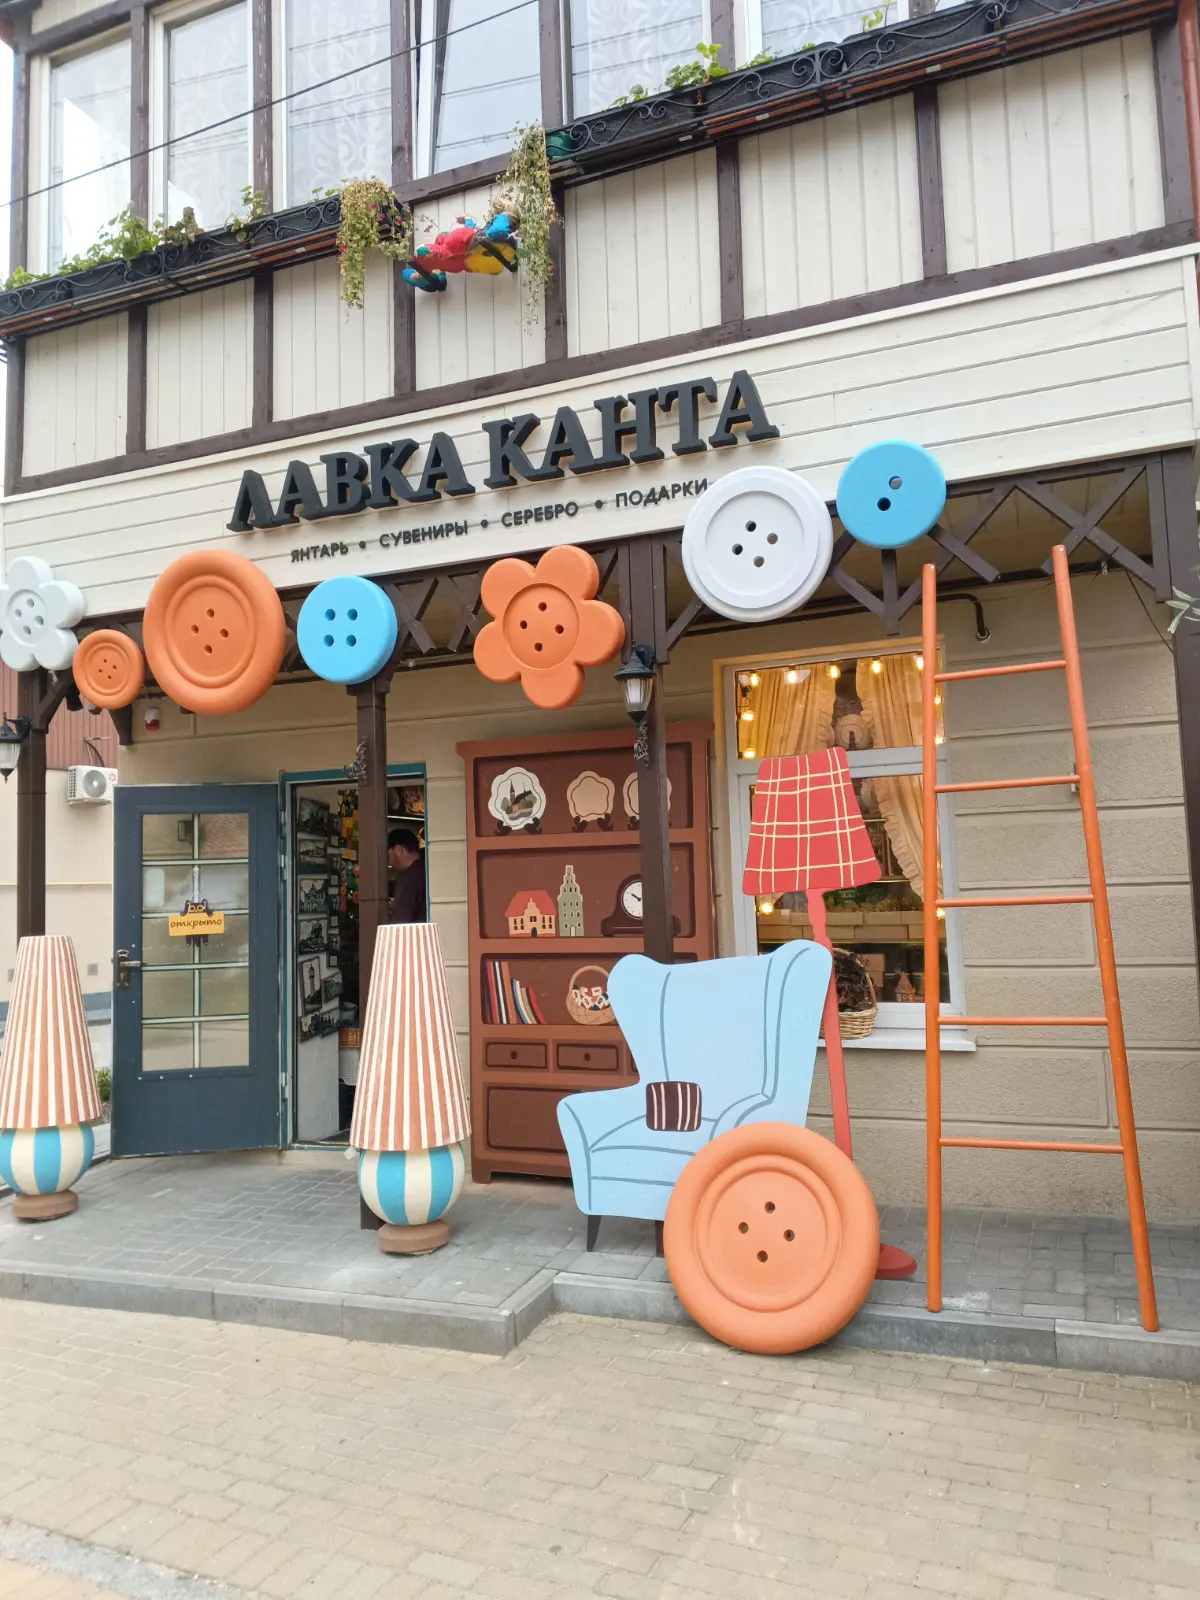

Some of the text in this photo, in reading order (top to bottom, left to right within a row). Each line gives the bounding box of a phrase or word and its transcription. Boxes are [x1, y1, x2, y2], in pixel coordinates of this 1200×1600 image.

[226, 369, 780, 533] ЛАВКА КАНТА
[291, 478, 708, 563] ЯНТАРЬ СУВЕНИРЫ СЕРЕБРО ПОДАРКИ
[170, 918, 222, 930] открыто
